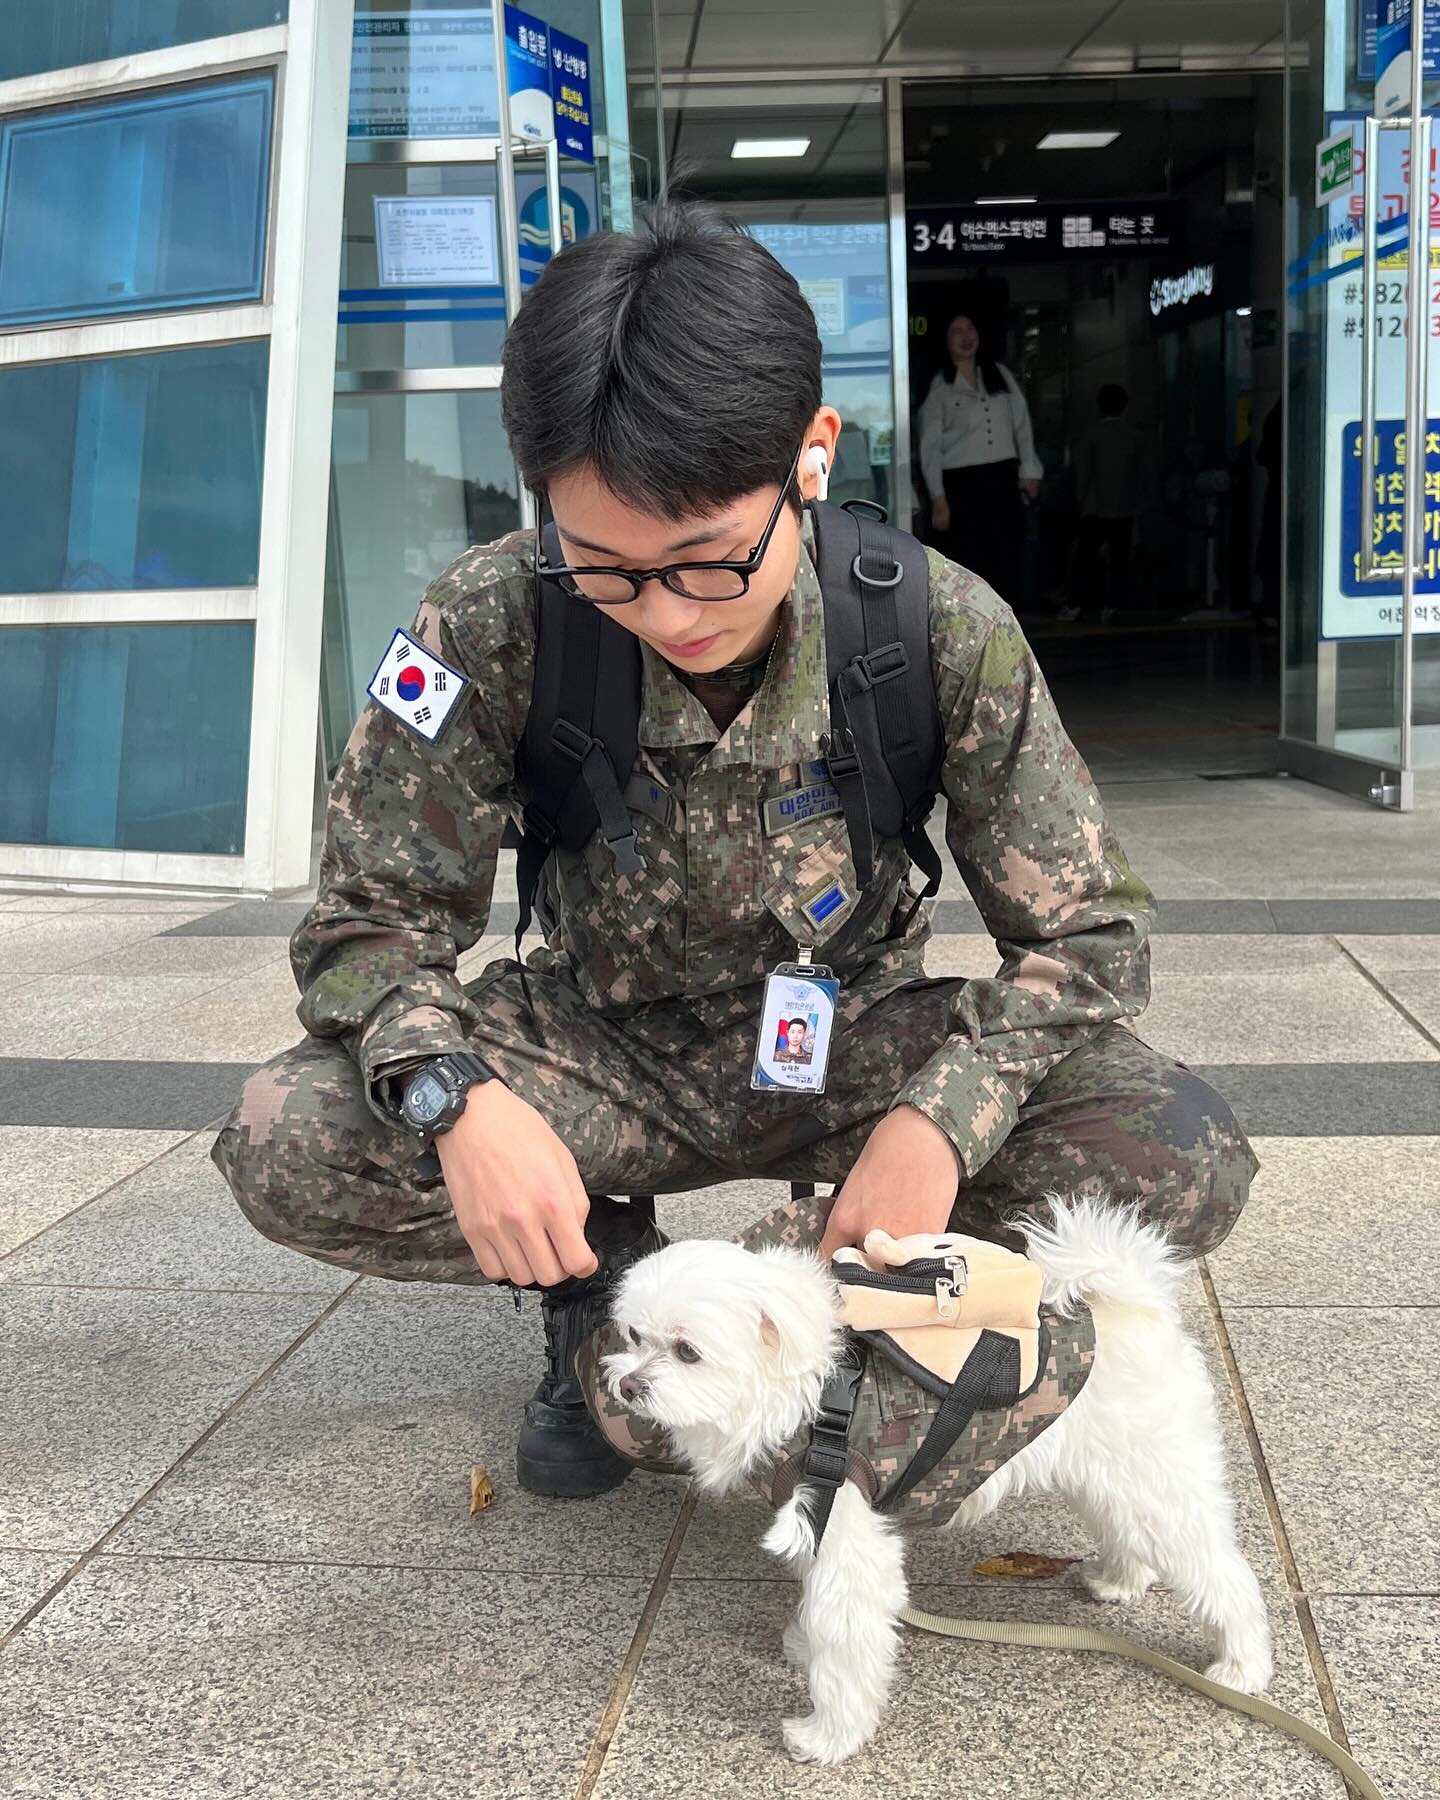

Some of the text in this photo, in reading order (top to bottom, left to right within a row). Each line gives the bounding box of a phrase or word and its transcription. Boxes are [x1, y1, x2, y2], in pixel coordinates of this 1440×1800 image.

[517, 25, 547, 58] 출입문
[1344, 282, 1402, 305] #82
[1343, 316, 1401, 339] #12
